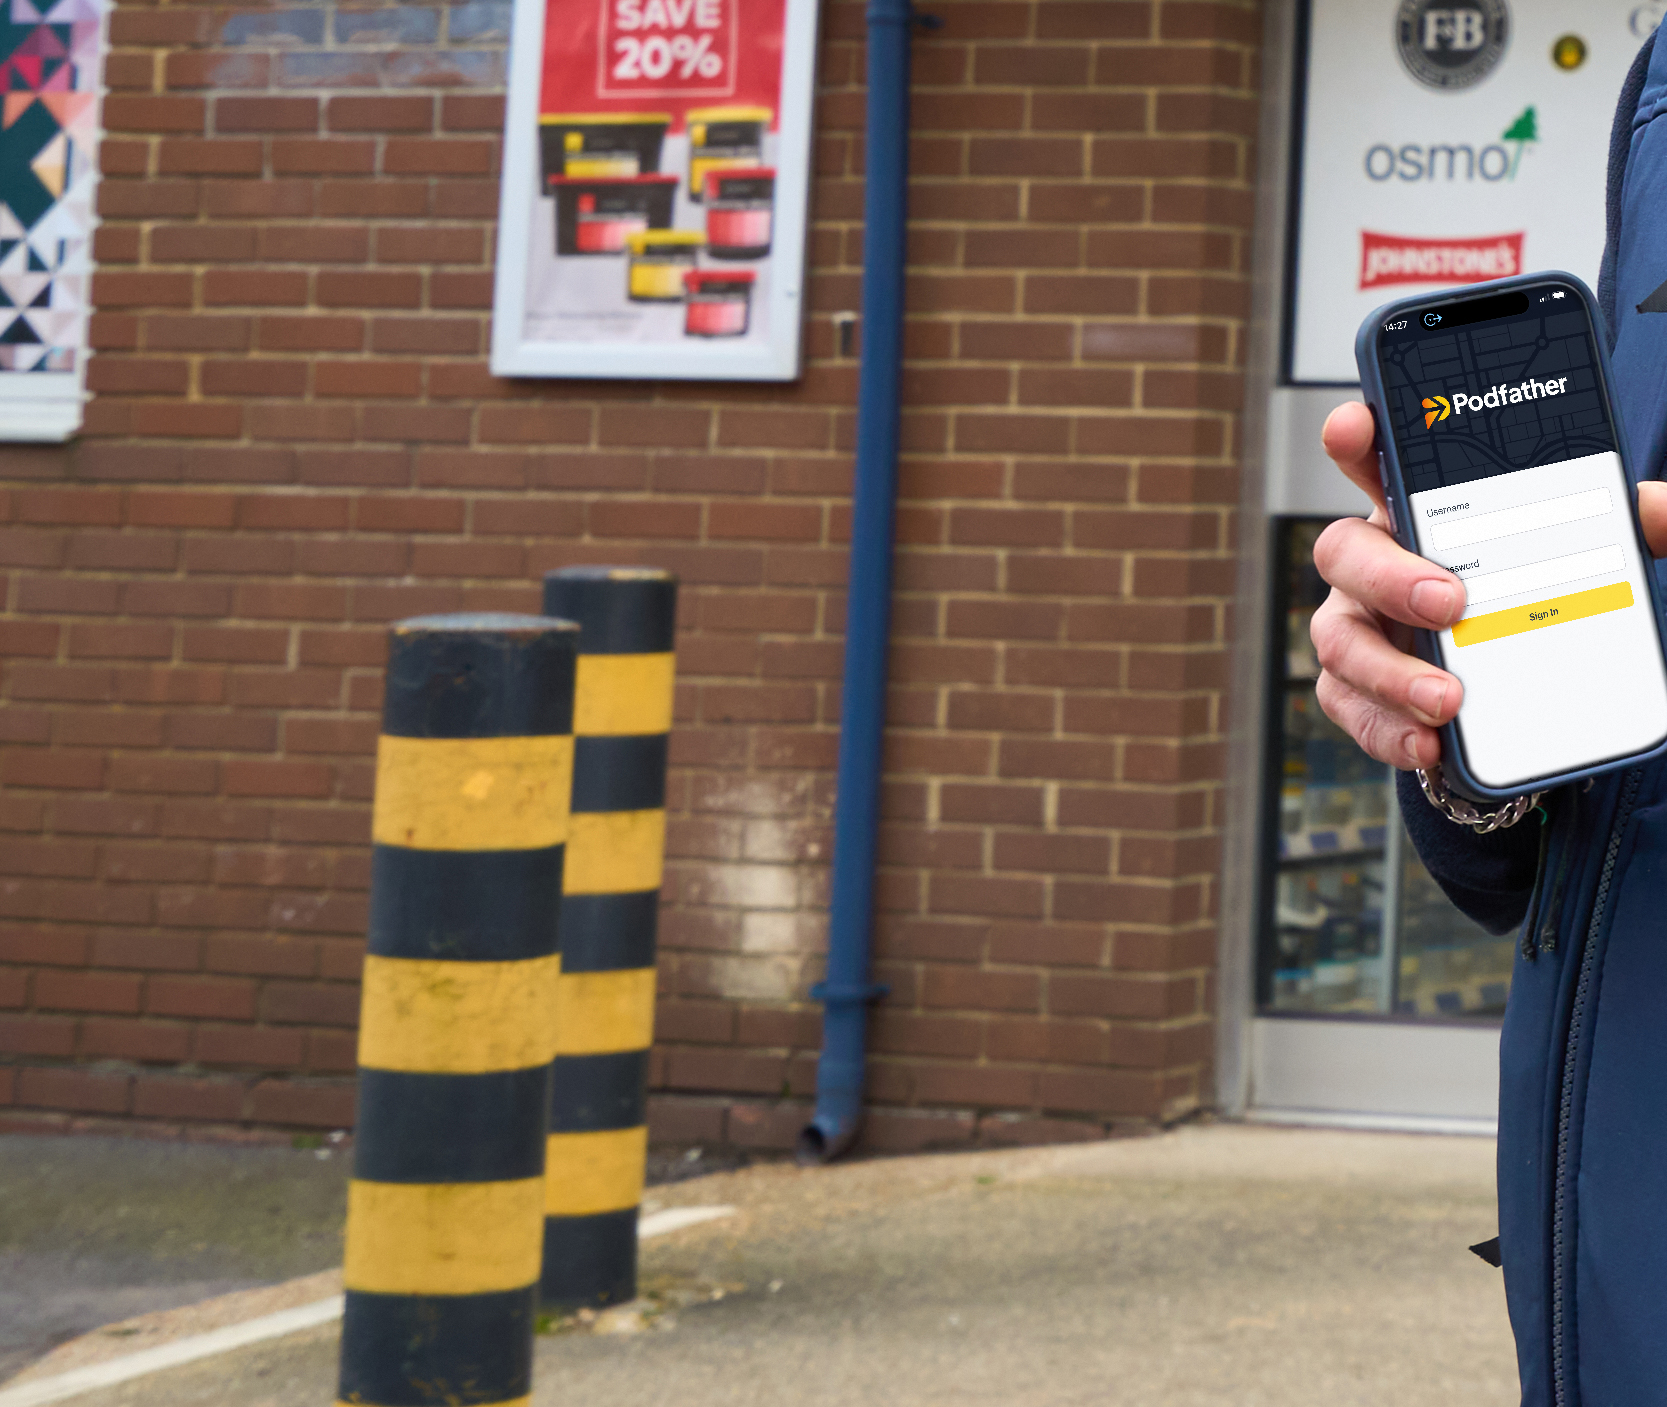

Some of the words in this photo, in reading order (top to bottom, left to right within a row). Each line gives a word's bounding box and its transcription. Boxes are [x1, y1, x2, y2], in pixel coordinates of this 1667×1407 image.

[612, 33, 723, 81] 20%
[1363, 142, 1510, 183] osmo
[1383, 320, 1408, 332] 14:27
[1451, 376, 1568, 415] Podfather
[1426, 502, 1470, 518] Username
[1529, 611, 1549, 622] Sign
[1550, 608, 1559, 617] In
